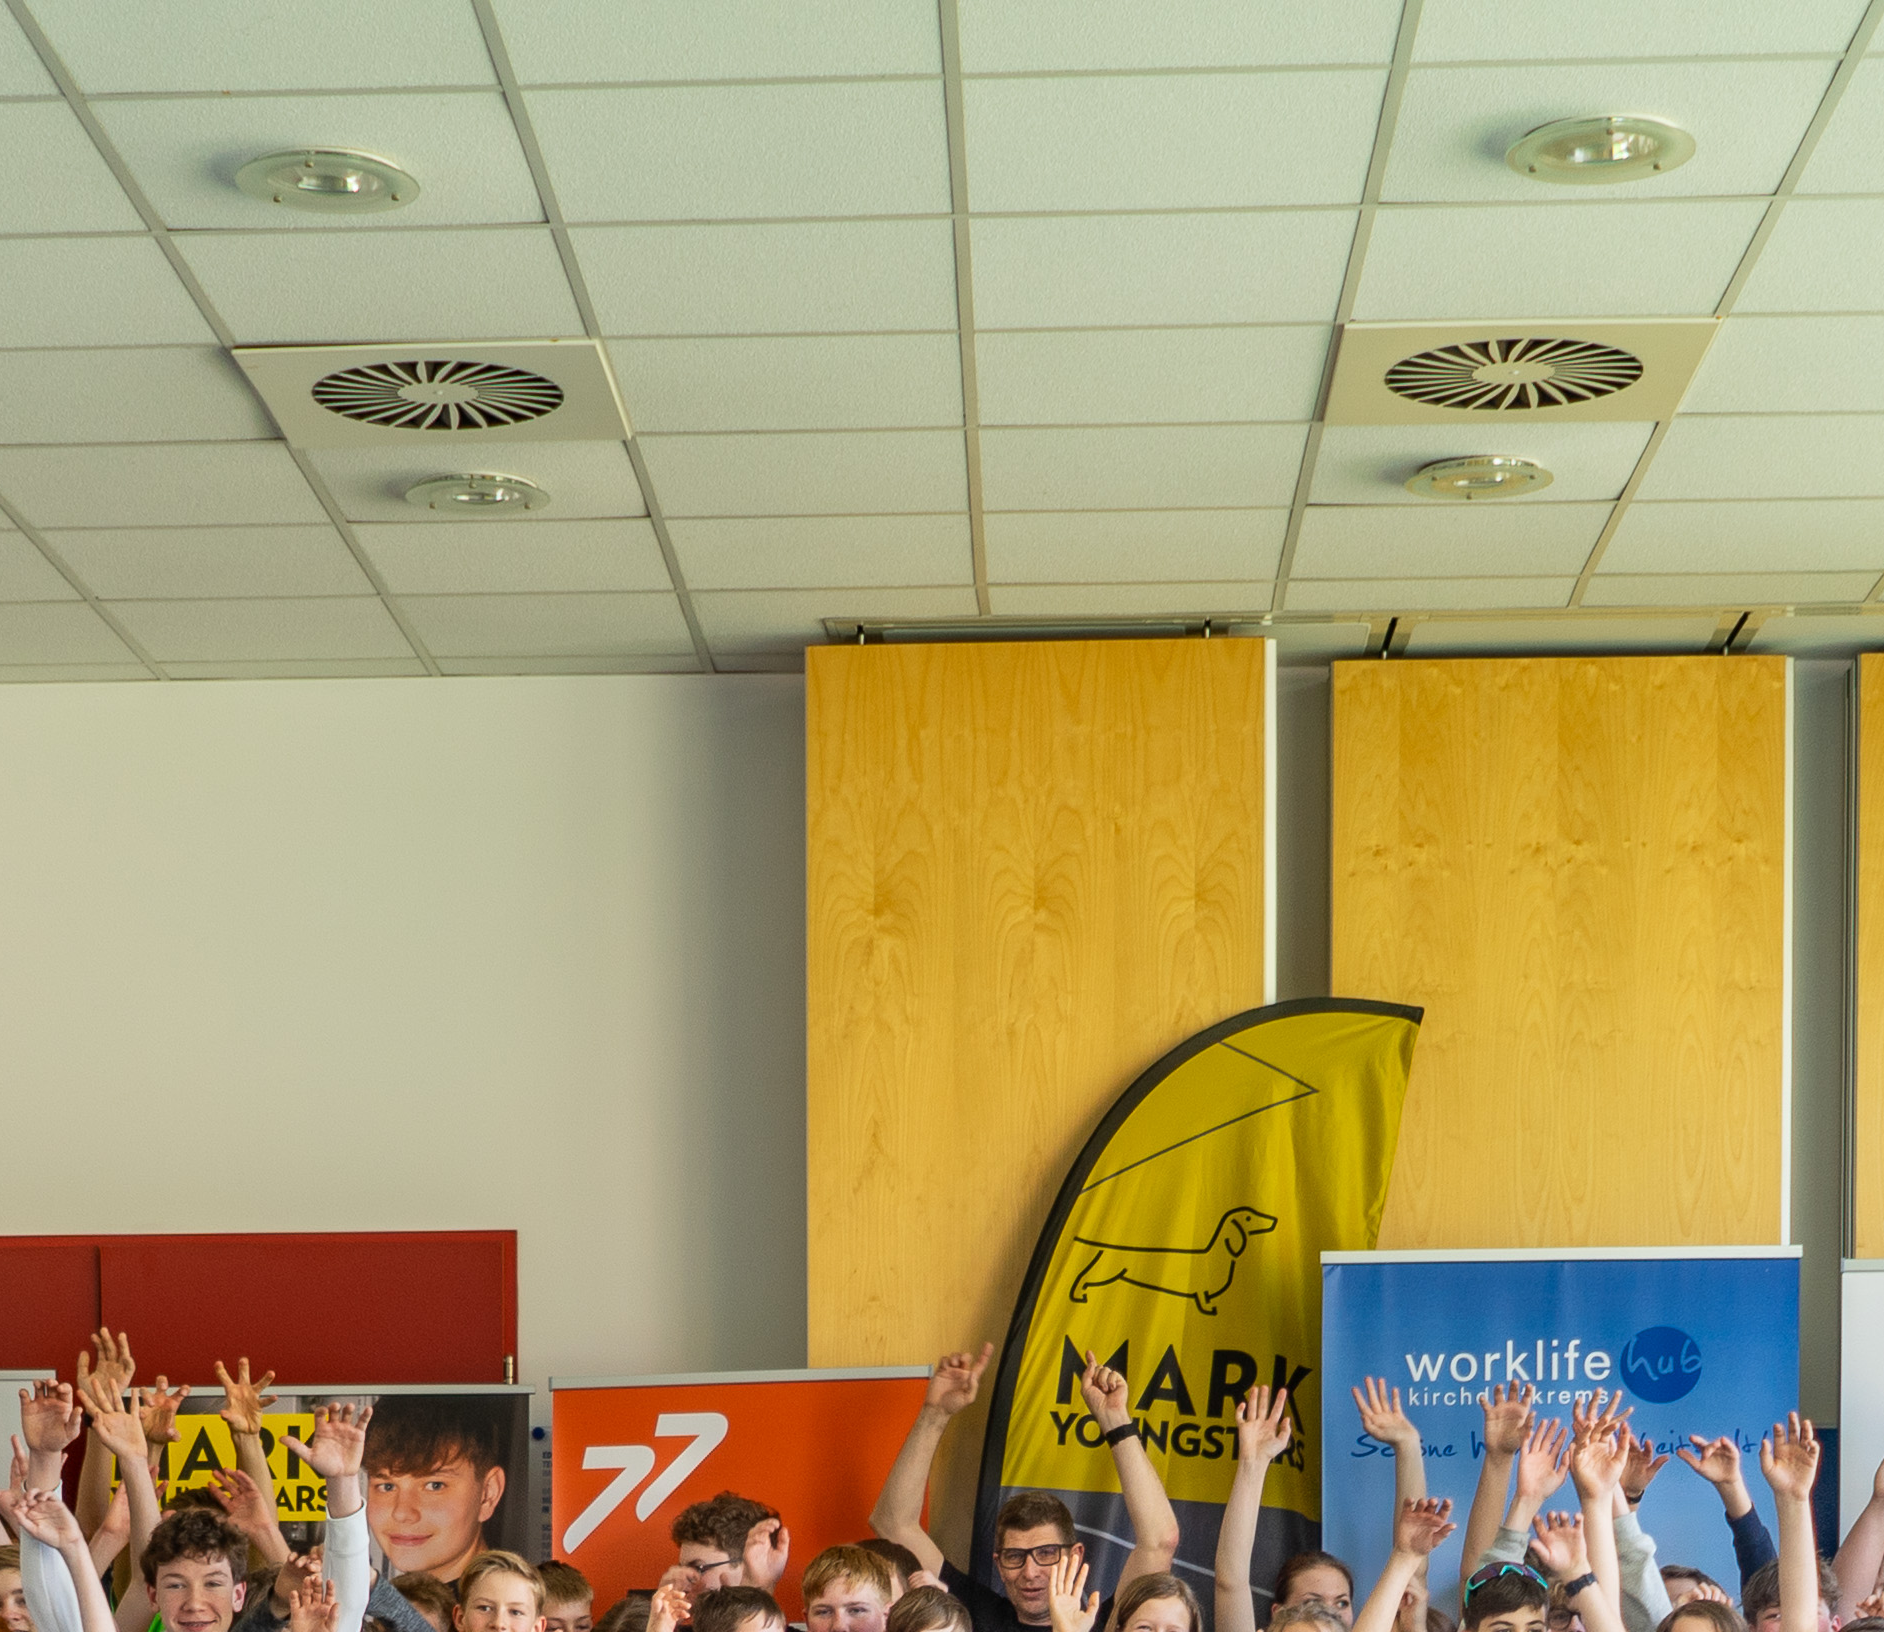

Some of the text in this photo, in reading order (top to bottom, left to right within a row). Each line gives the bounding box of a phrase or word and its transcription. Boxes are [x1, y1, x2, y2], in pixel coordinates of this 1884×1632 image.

[1404, 1339, 1612, 1383] worklife
[1626, 1336, 1703, 1382] hub
[1049, 1411, 1305, 1473] YONGSTRS
